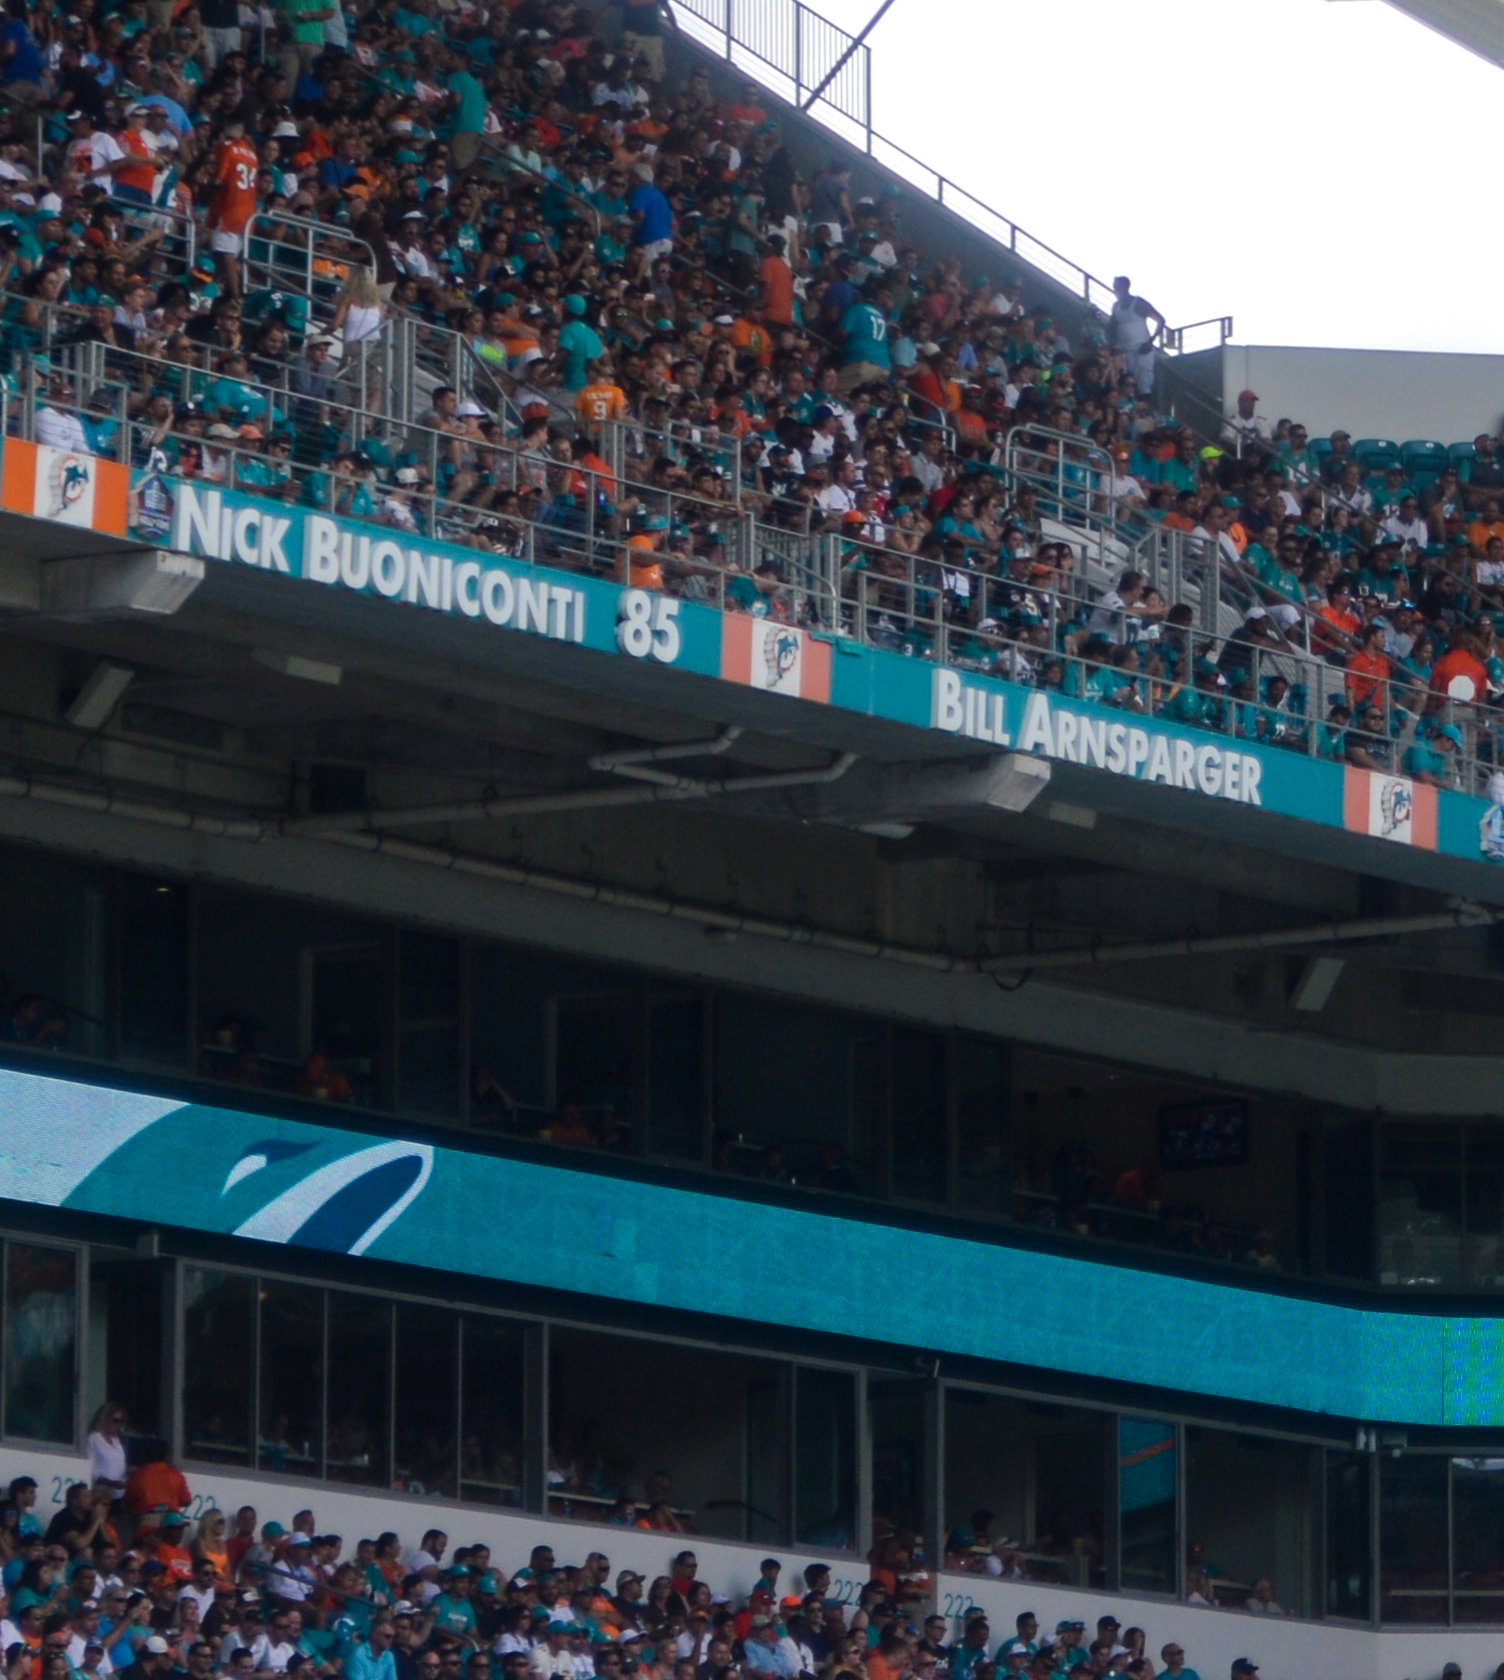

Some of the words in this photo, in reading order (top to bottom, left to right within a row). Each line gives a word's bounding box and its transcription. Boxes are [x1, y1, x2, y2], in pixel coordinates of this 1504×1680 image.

[173, 485, 290, 574] NICK
[304, 514, 586, 644] BUONICONTI
[615, 588, 682, 664] 85
[931, 668, 1011, 747] BILL
[1014, 693, 1262, 807] ARNSPARGER
